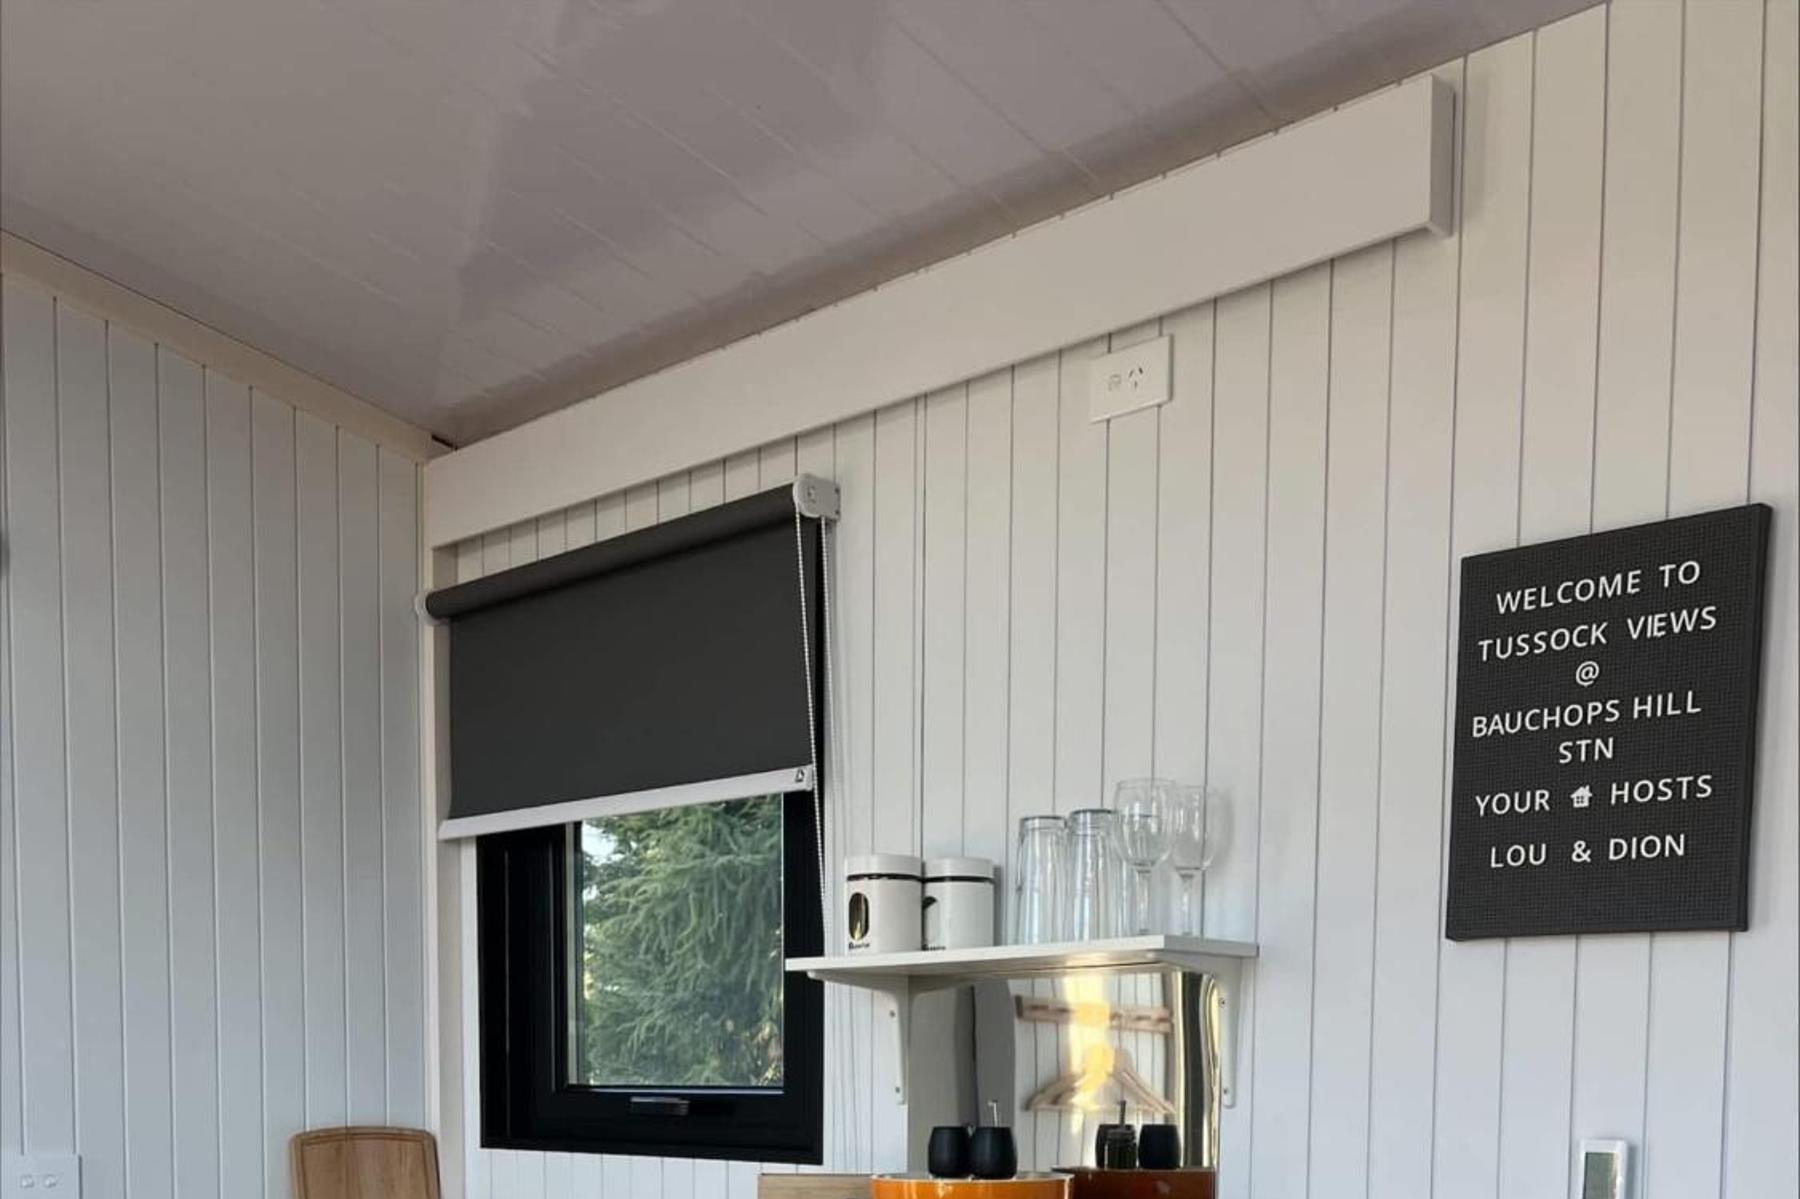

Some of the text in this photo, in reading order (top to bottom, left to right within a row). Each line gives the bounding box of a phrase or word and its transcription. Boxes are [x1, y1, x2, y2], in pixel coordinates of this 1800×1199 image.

[1496, 560, 1700, 615] WELCOME TO
[1477, 605, 1717, 662] TUSSOCK VIEWS
[1575, 660, 1600, 687] @
[1472, 690, 1702, 738] BAUCHOPS HILL
[1558, 737, 1614, 764] STN
[1475, 774, 1712, 817] YOUR HOSTS
[1490, 833, 1685, 869] LOU & DION
